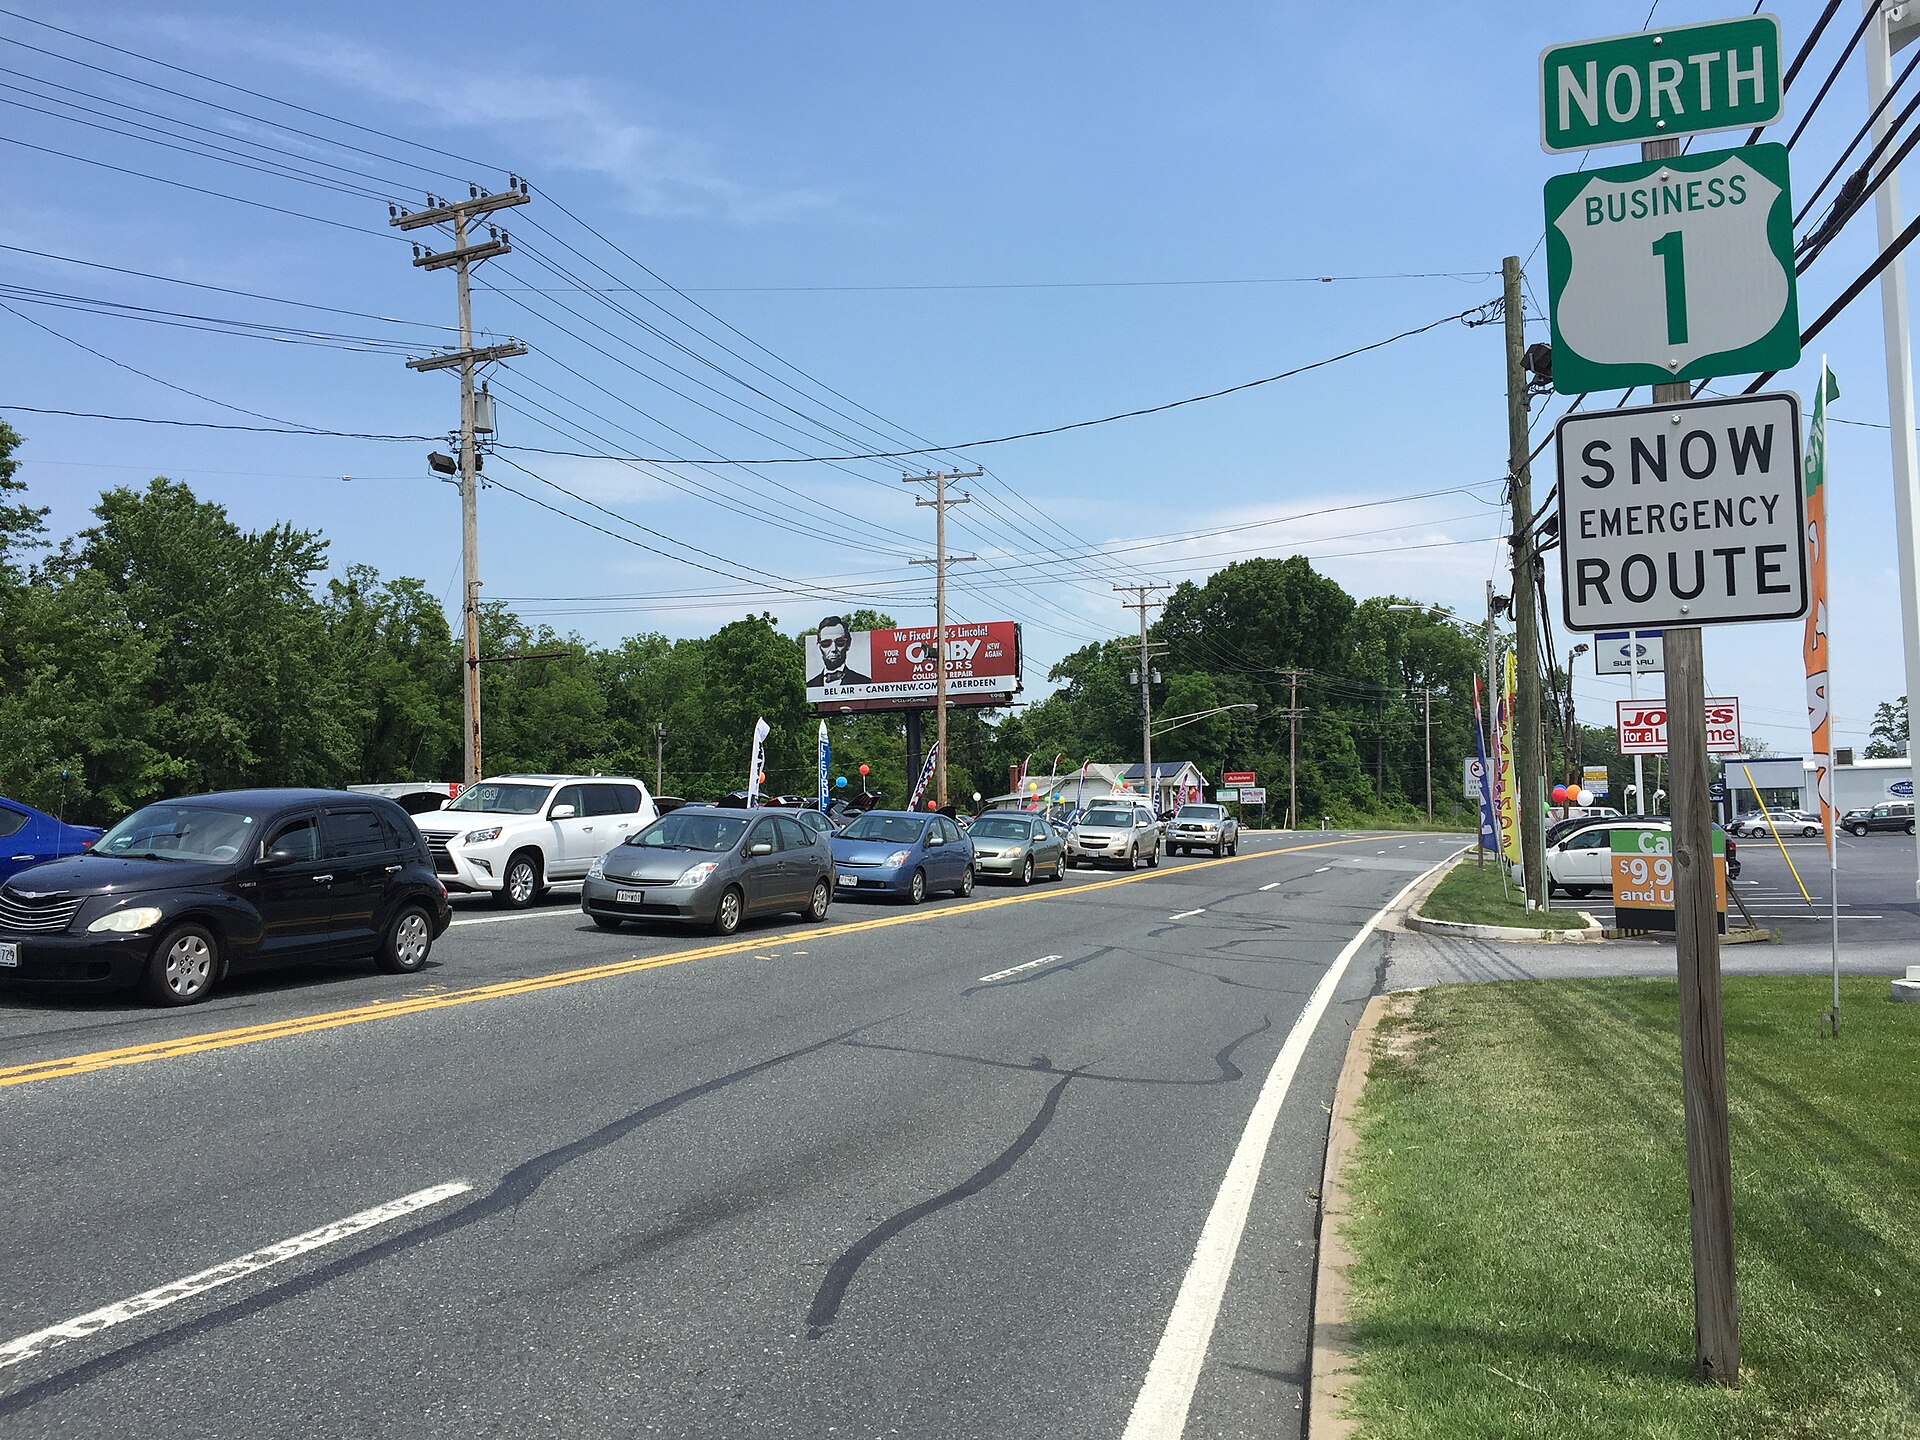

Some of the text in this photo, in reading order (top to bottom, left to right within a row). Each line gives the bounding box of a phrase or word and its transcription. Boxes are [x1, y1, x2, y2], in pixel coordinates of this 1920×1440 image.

[1558, 46, 1764, 131] NORTH
[1586, 174, 1747, 226] BUSINESS
[1652, 230, 1688, 346] 1
[1581, 424, 1774, 489] SNOW
[1580, 494, 1779, 539] EMERGENCY
[1576, 544, 1790, 607] ROUTE
[894, 631, 906, 642] We
[909, 630, 931, 641] Fixed
[958, 626, 988, 637] Lincoln!
[884, 649, 899, 657] YOUR
[913, 661, 972, 673] MOORS
[825, 688, 838, 696] BEL
[951, 679, 996, 689] ABERDEEN
[1624, 730, 1641, 742] for
[1645, 732, 1652, 742] a
[1620, 888, 1655, 902] and
